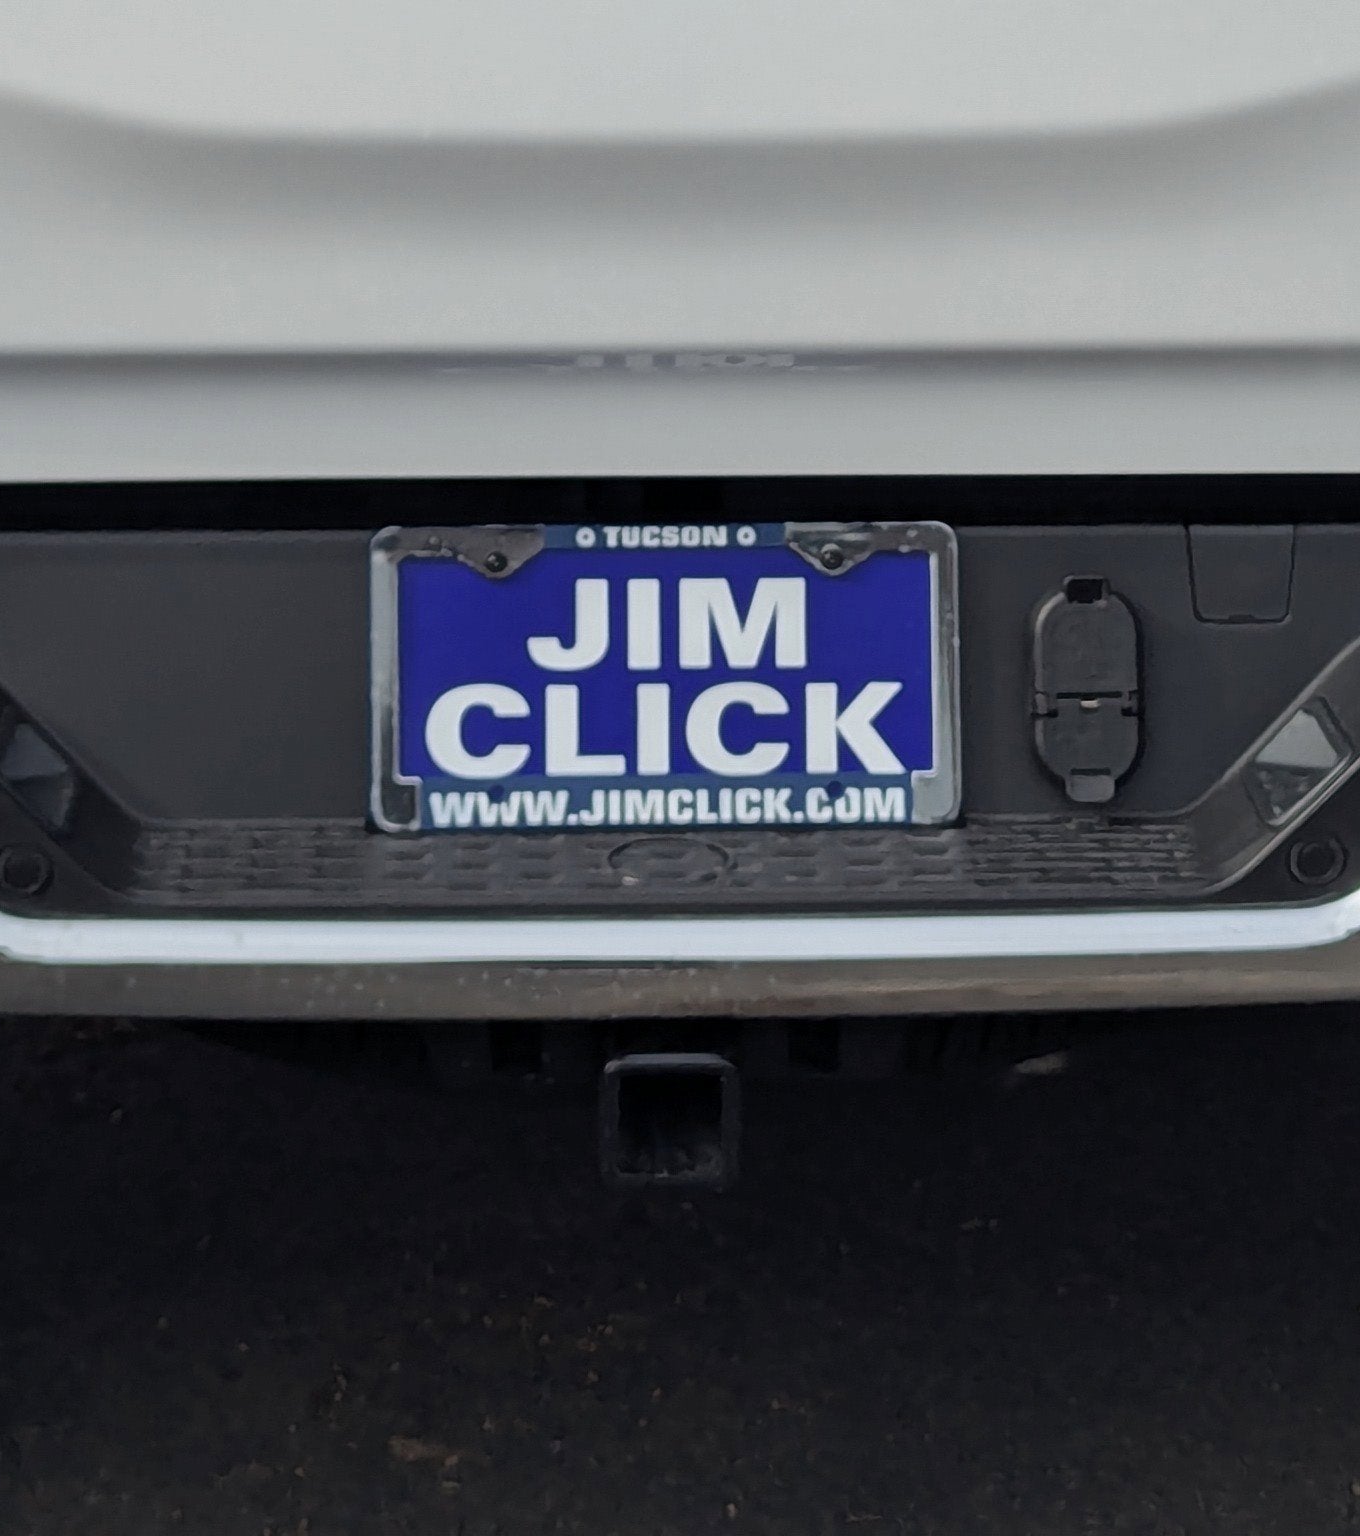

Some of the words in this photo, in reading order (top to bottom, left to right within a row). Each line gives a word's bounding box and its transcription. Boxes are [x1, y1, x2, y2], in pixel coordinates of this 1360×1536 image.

[603, 524, 728, 549] TUCSON
[526, 576, 807, 672] JIM
[425, 681, 906, 780] CLICK
[429, 786, 907, 828] WWW.JIMCLICK.COM
